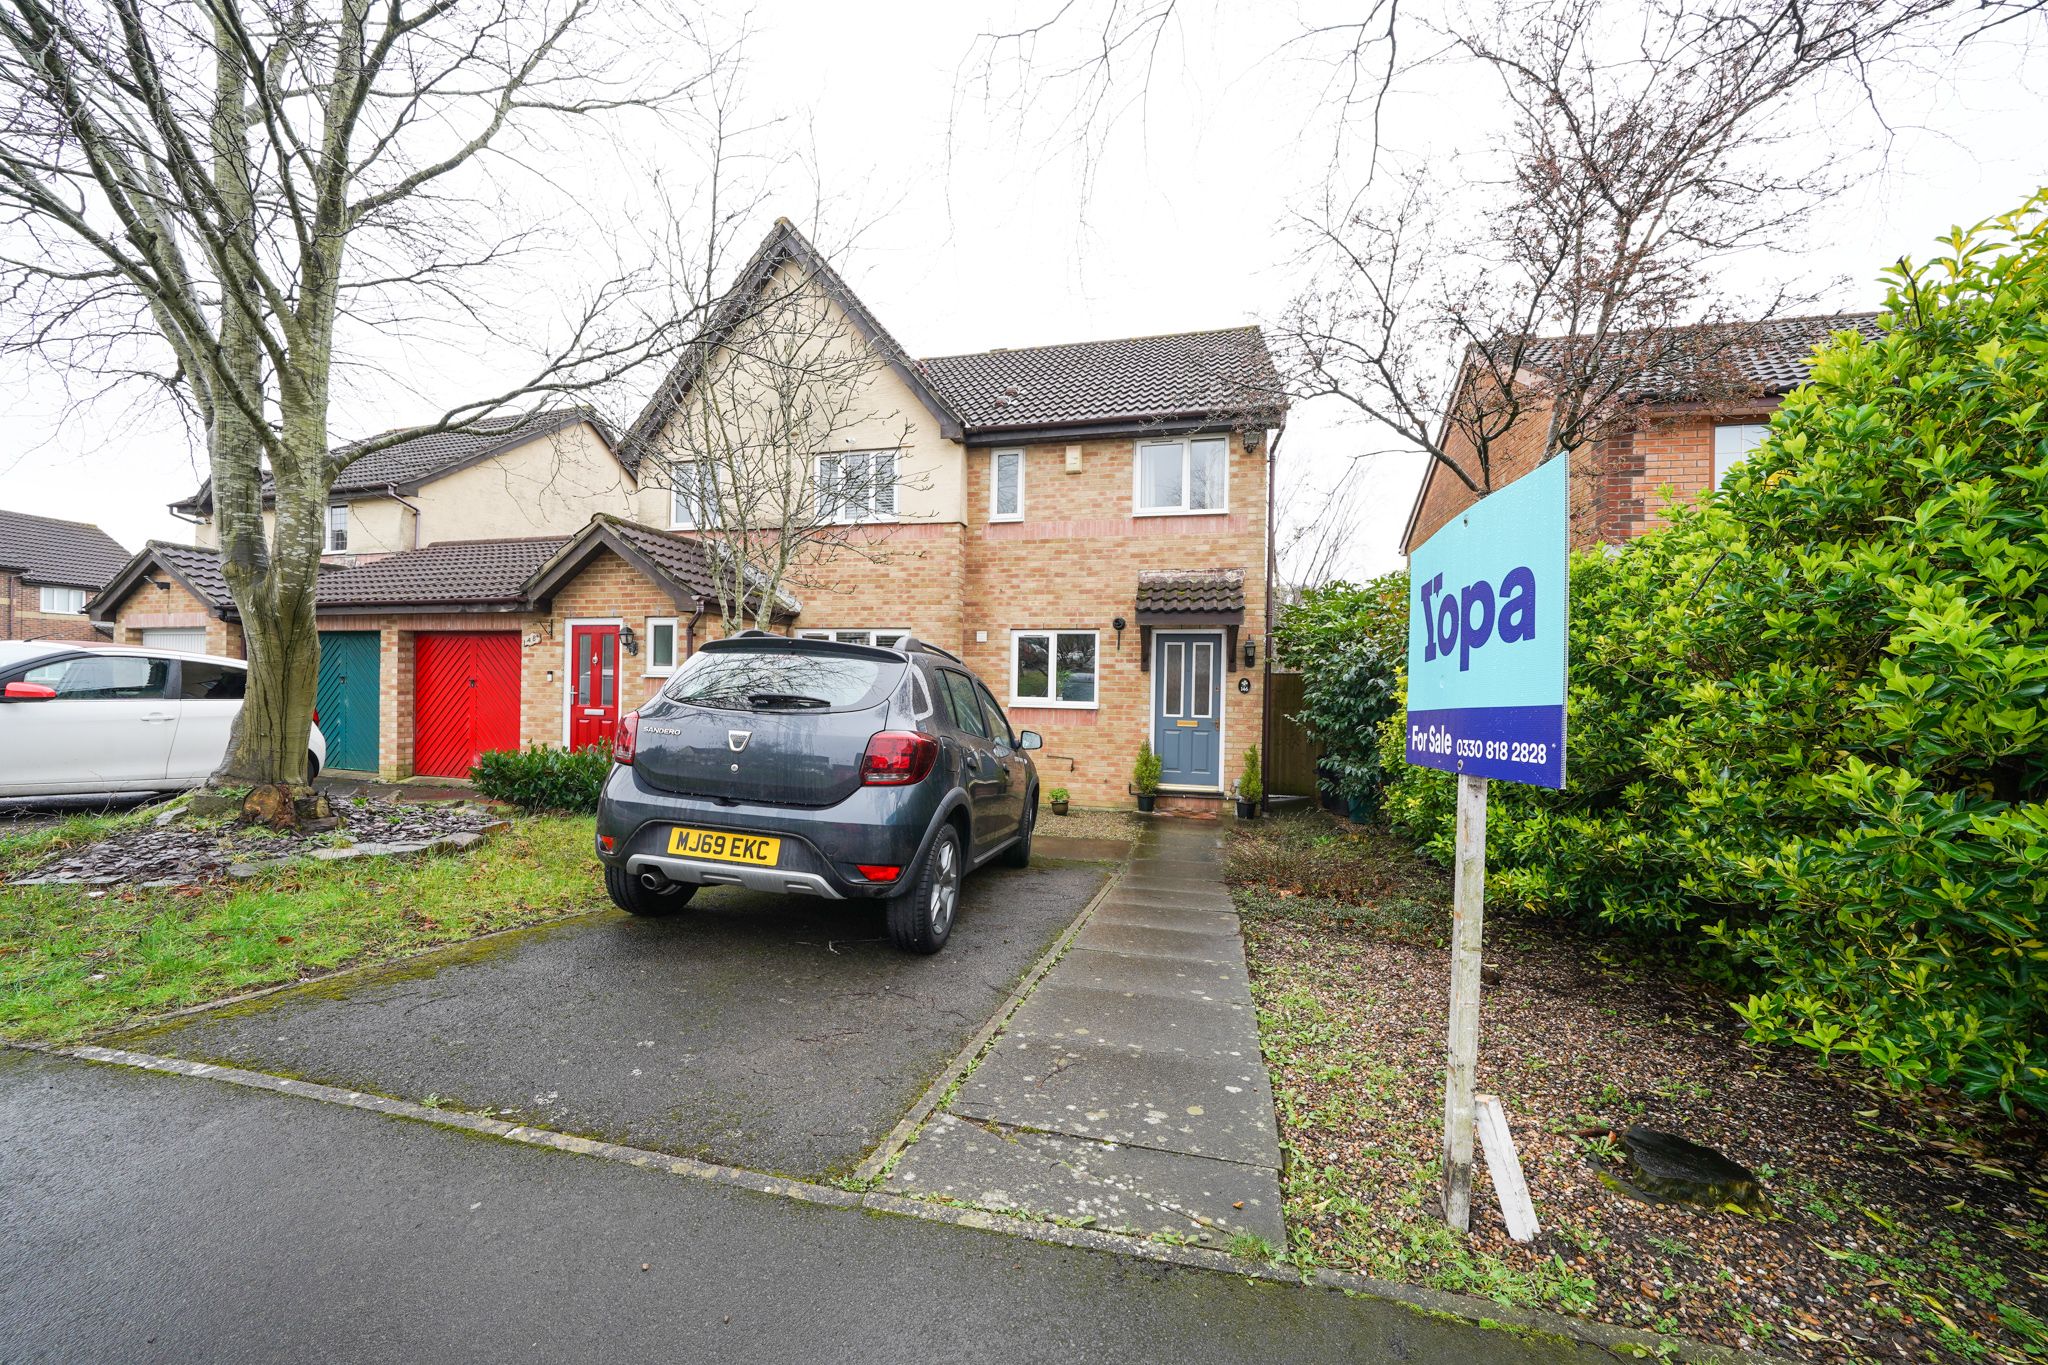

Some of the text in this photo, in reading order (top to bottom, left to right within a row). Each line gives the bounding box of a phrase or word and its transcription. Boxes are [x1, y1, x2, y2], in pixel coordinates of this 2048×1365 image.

[643, 726, 681, 736] SANDERO
[1411, 724, 1547, 765] For Sale 0330 818 2828
[676, 831, 770, 860] MJ69 EKC
